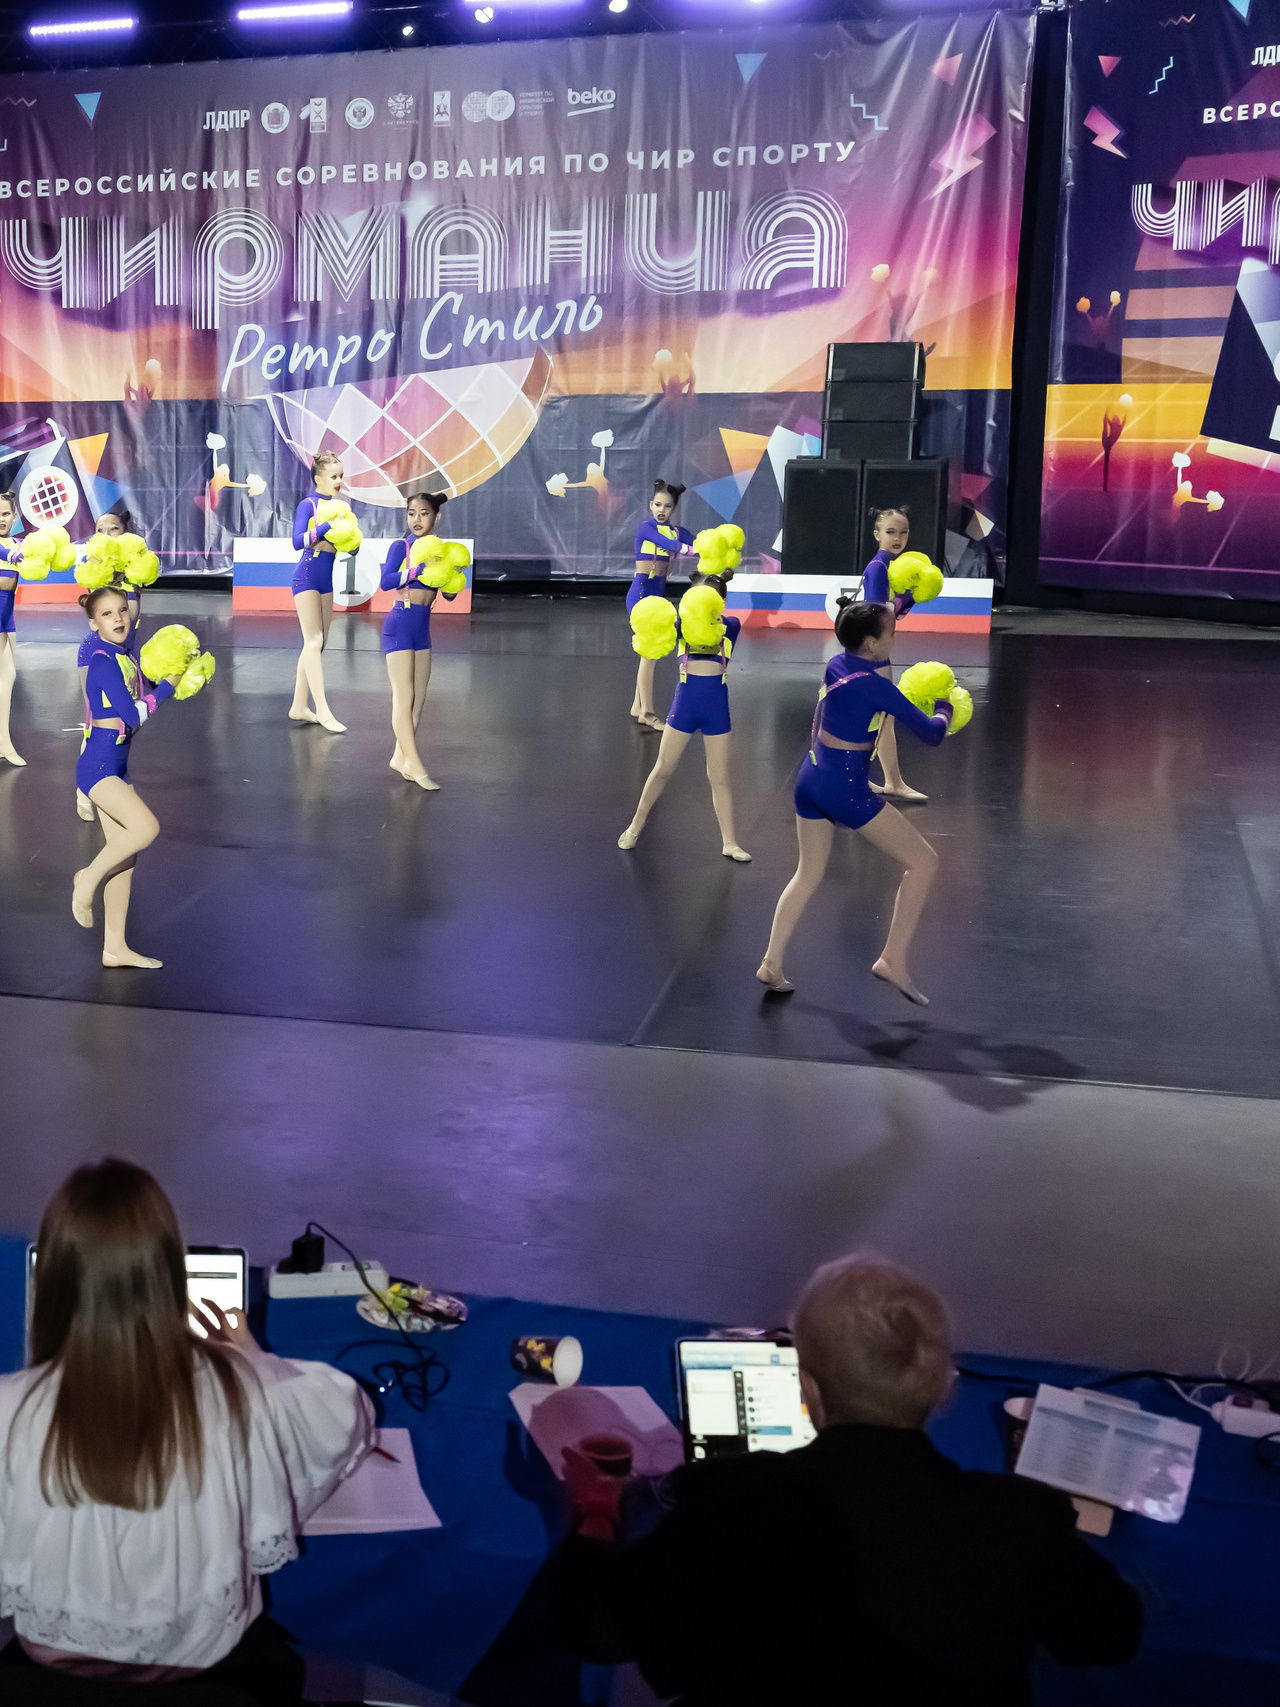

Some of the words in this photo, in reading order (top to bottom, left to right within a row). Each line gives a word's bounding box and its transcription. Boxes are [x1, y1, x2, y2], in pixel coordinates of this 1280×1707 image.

[567, 86, 616, 105] beko
[202, 109, 251, 132] ЛДПР
[275, 155, 546, 186] СОРЕВНОВАНИЯ
[563, 152, 610, 174] ПО
[626, 149, 696, 171] ЧИР
[713, 141, 857, 167] СПОРТУ
[1131, 174, 1280, 265] ЧИ
[221, 322, 397, 392] Ретро
[419, 290, 605, 360] Стиль
[339, 554, 361, 595] 1
